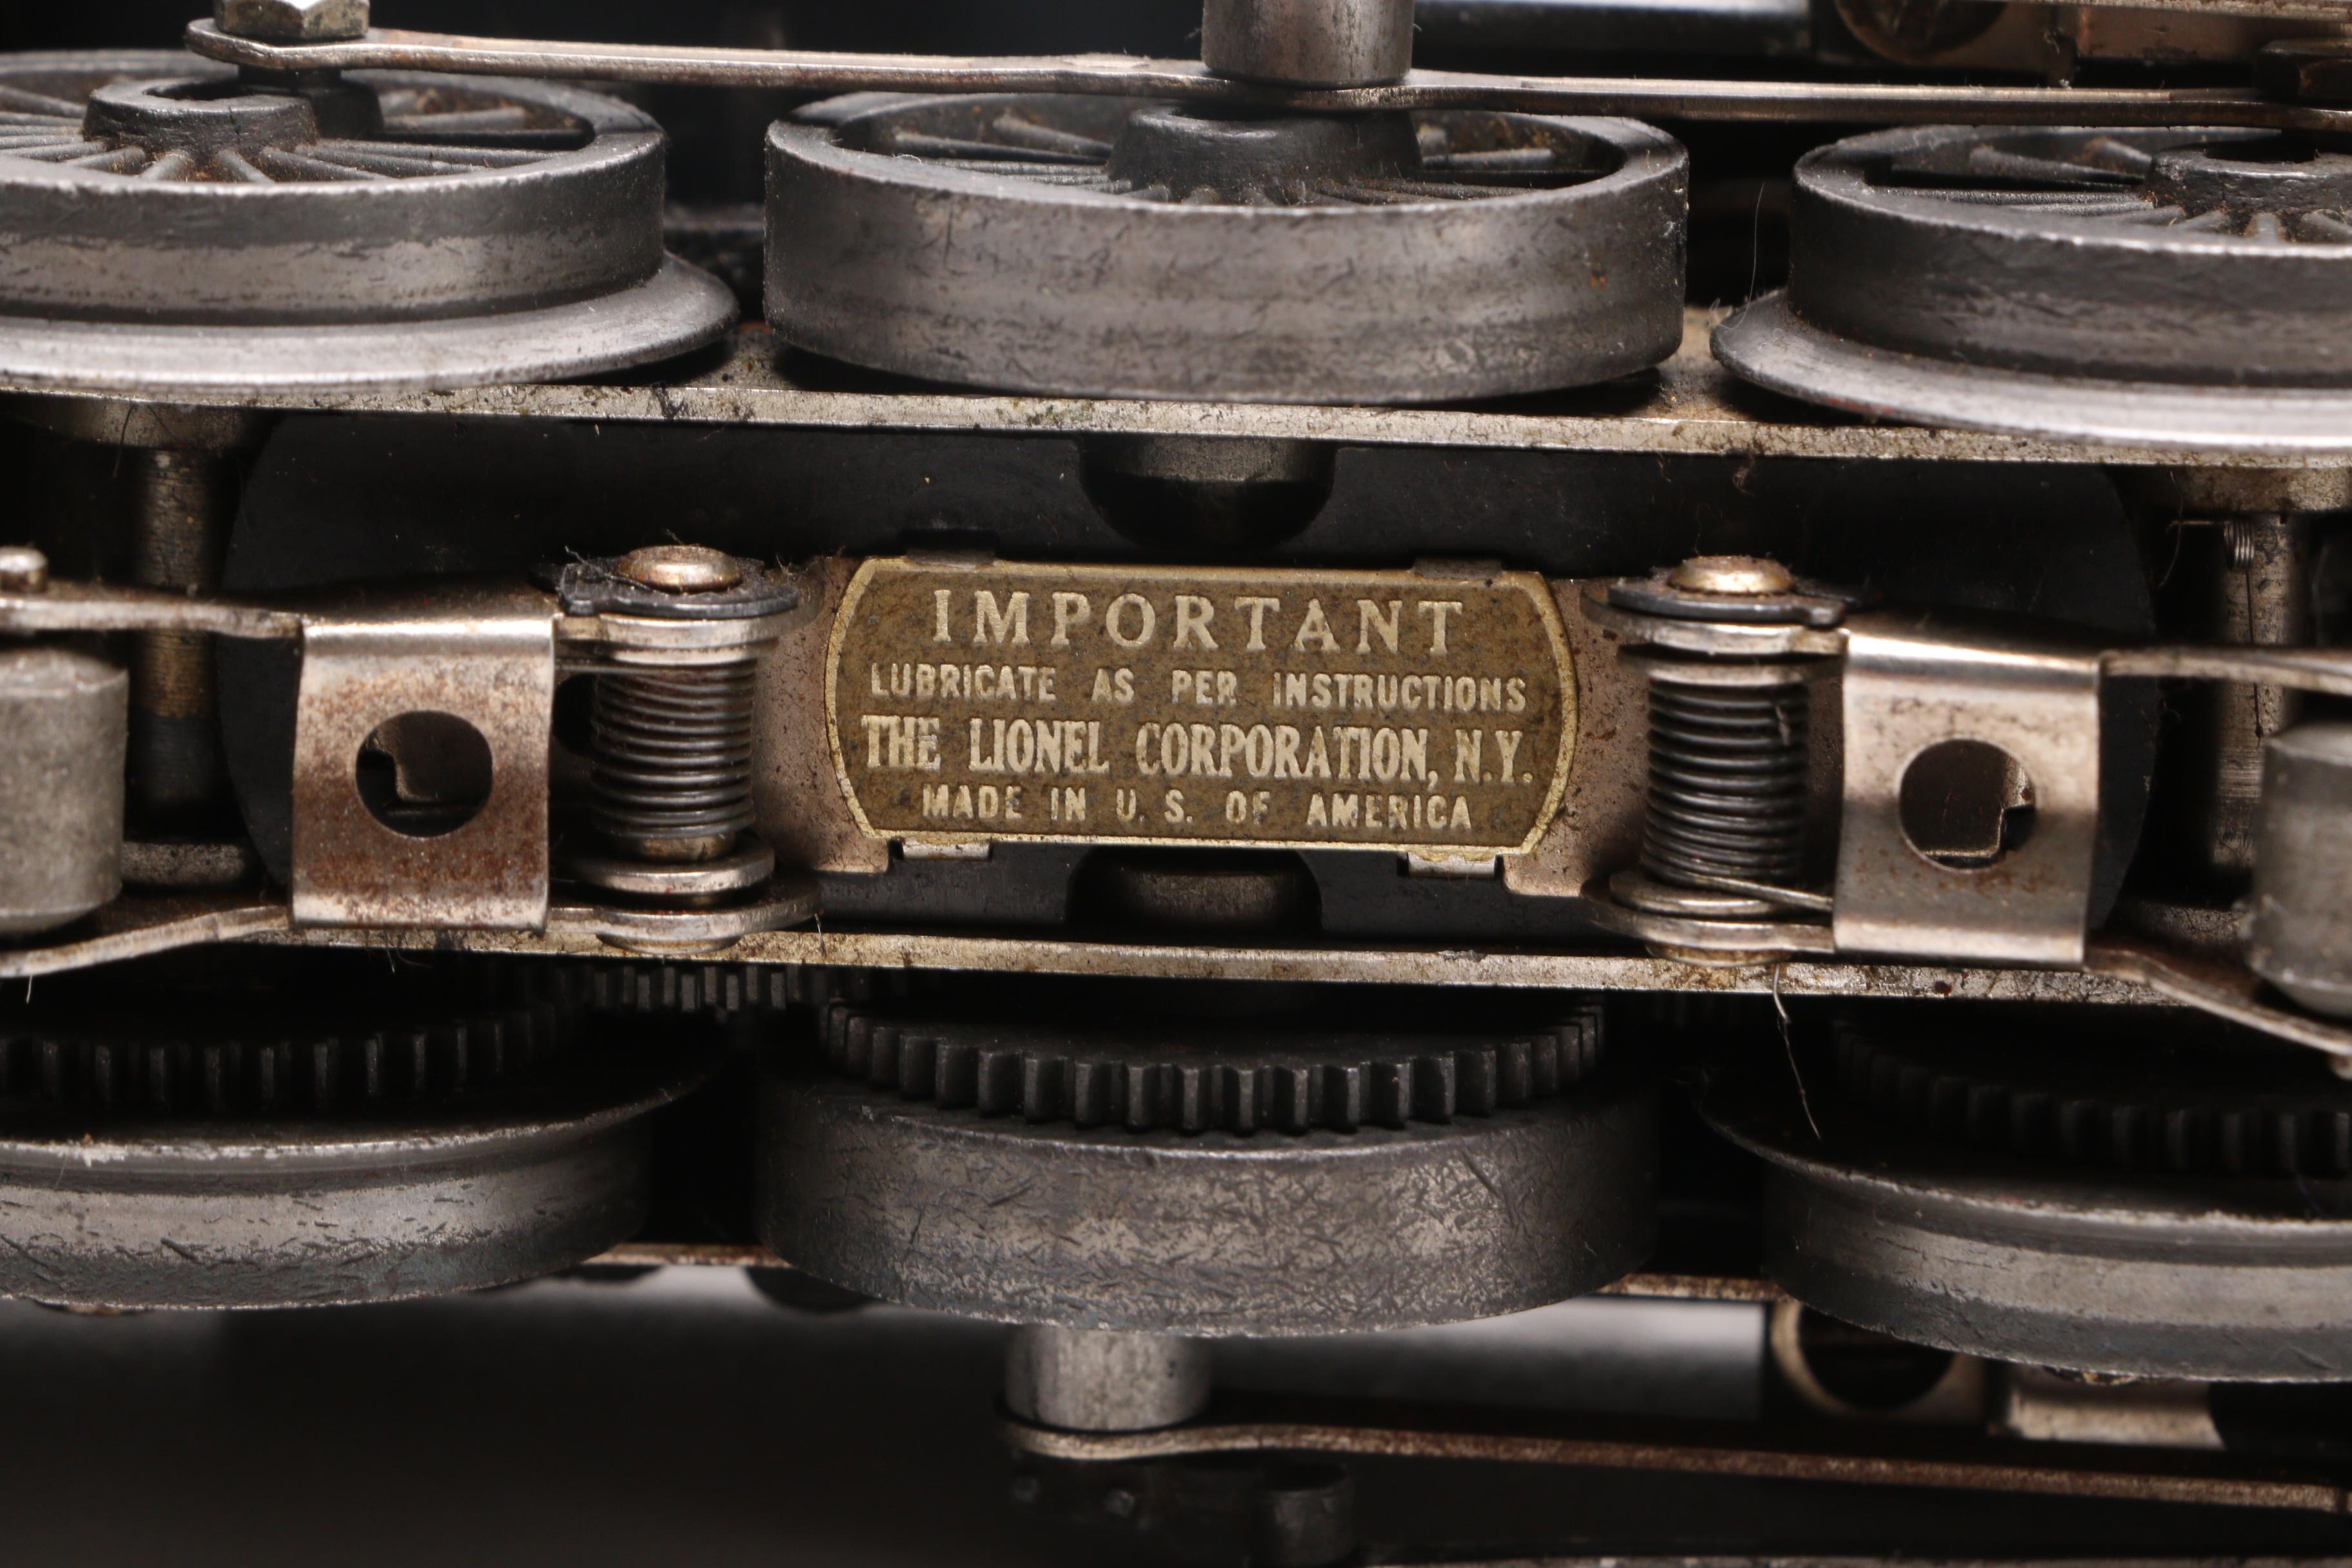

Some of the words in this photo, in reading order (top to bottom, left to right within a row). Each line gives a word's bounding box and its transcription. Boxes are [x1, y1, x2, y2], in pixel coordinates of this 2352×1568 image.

[932, 589, 1463, 655] IMPORTANT
[870, 663, 1056, 701] LUBRICATE
[1092, 667, 1135, 703] AS
[1171, 669, 1237, 707] PER
[1273, 672, 1526, 712] INSTRUCTIONS
[861, 714, 941, 770] THE
[968, 718, 1110, 774] LIONEL
[1135, 721, 1438, 792] CORPORATION,
[922, 783, 1022, 819] MADE
[1050, 787, 1086, 821] IN
[1226, 790, 1270, 825] OF
[1306, 792, 1471, 830] AMERICA
